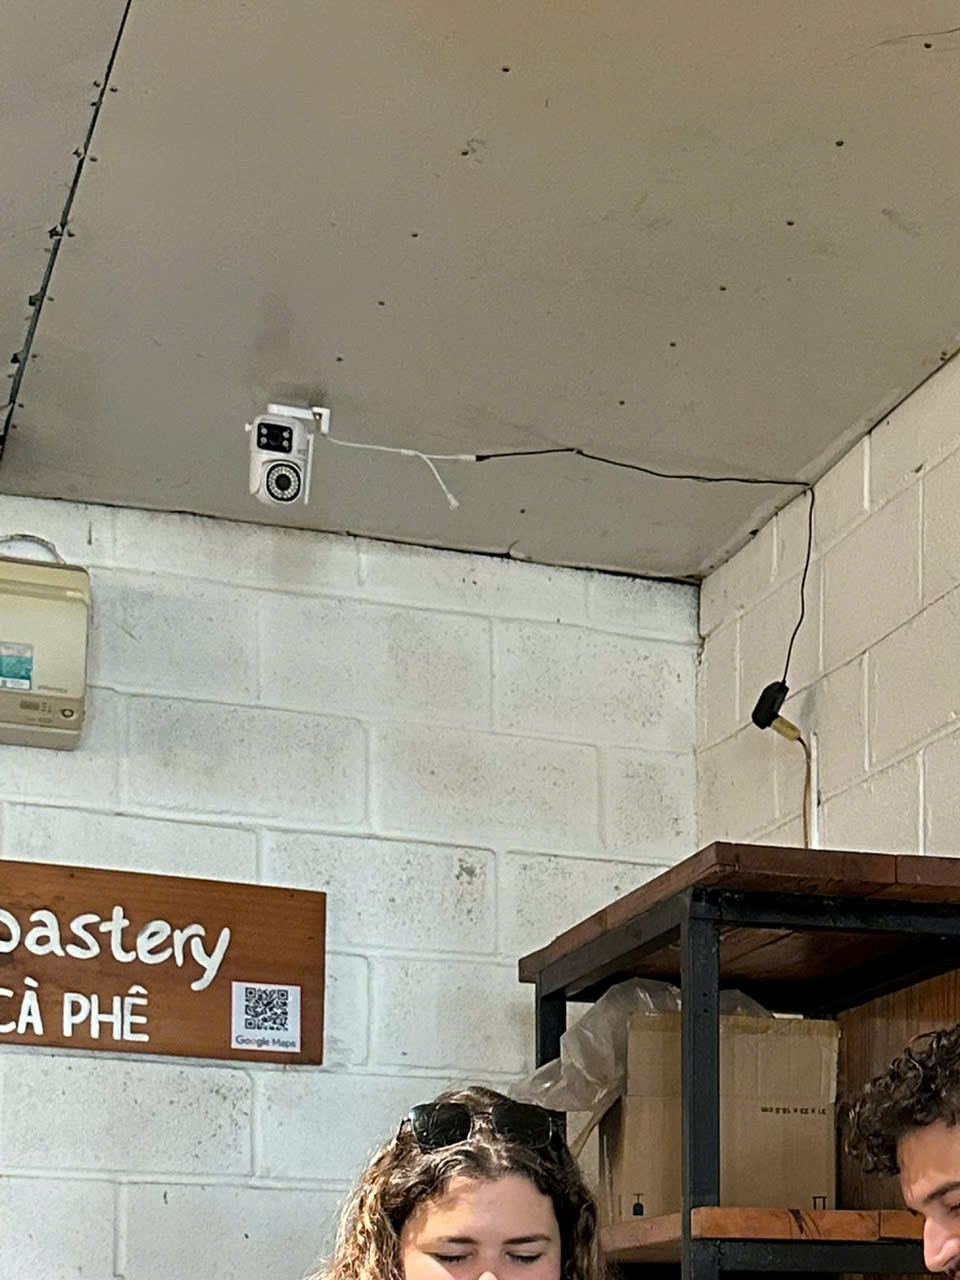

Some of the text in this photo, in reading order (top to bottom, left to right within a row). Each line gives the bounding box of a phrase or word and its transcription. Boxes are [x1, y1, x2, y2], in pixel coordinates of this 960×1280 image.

[62, 984, 150, 1042] PHÊ
[235, 1034, 297, 1048] Google Maps
